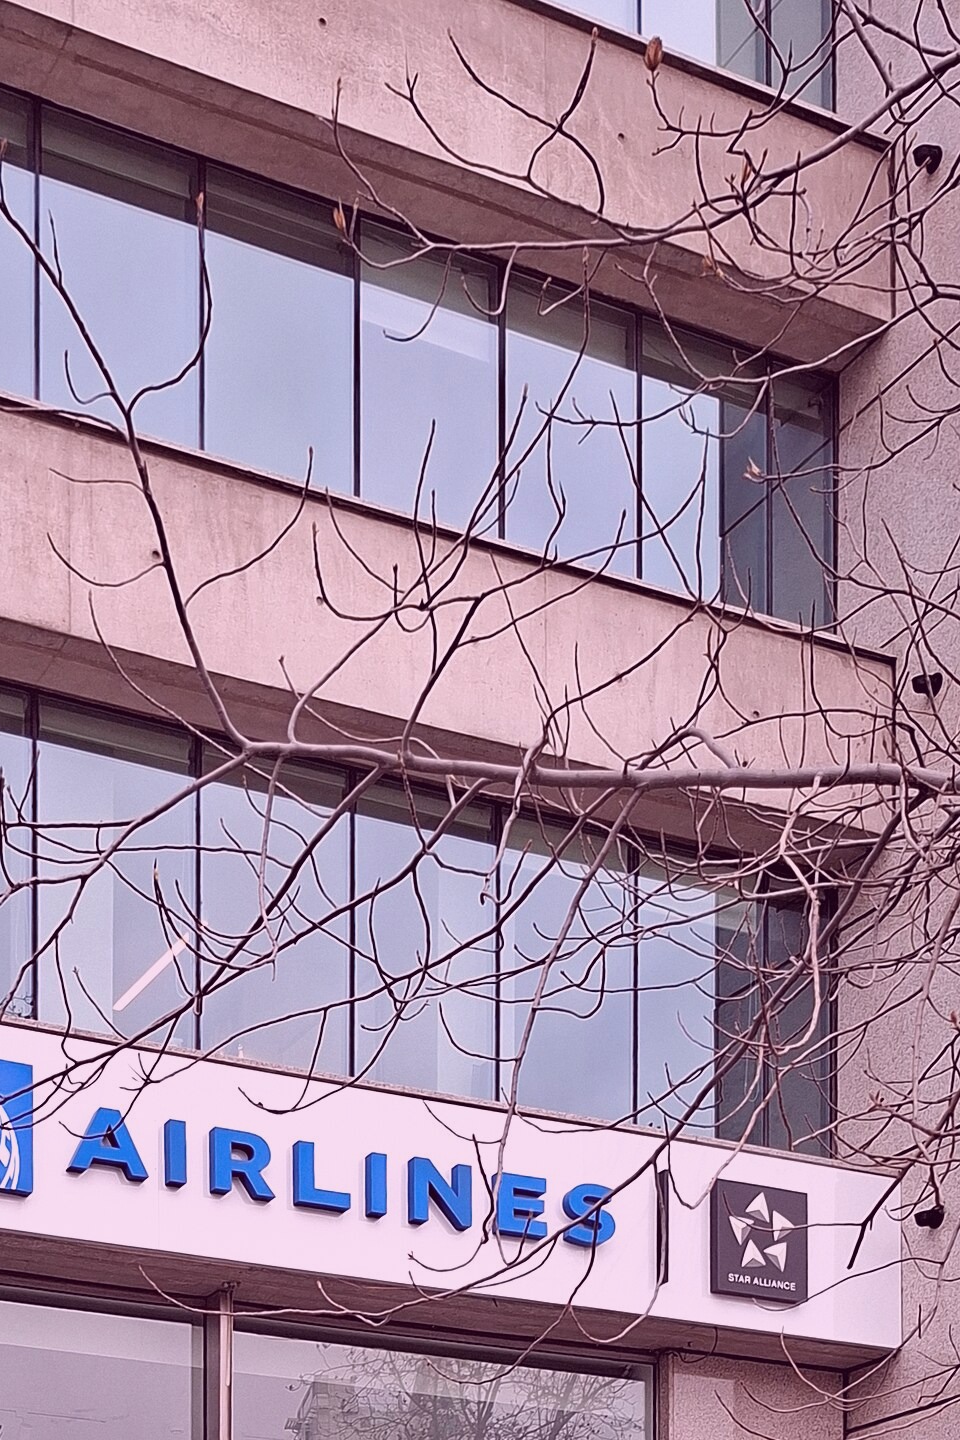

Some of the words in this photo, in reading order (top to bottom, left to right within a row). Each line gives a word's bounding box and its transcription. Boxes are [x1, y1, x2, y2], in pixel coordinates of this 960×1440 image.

[66, 1106, 616, 1249] AIRLINES
[728, 1273, 751, 1284] STAR
[753, 1277, 796, 1290] ALLIANCE
